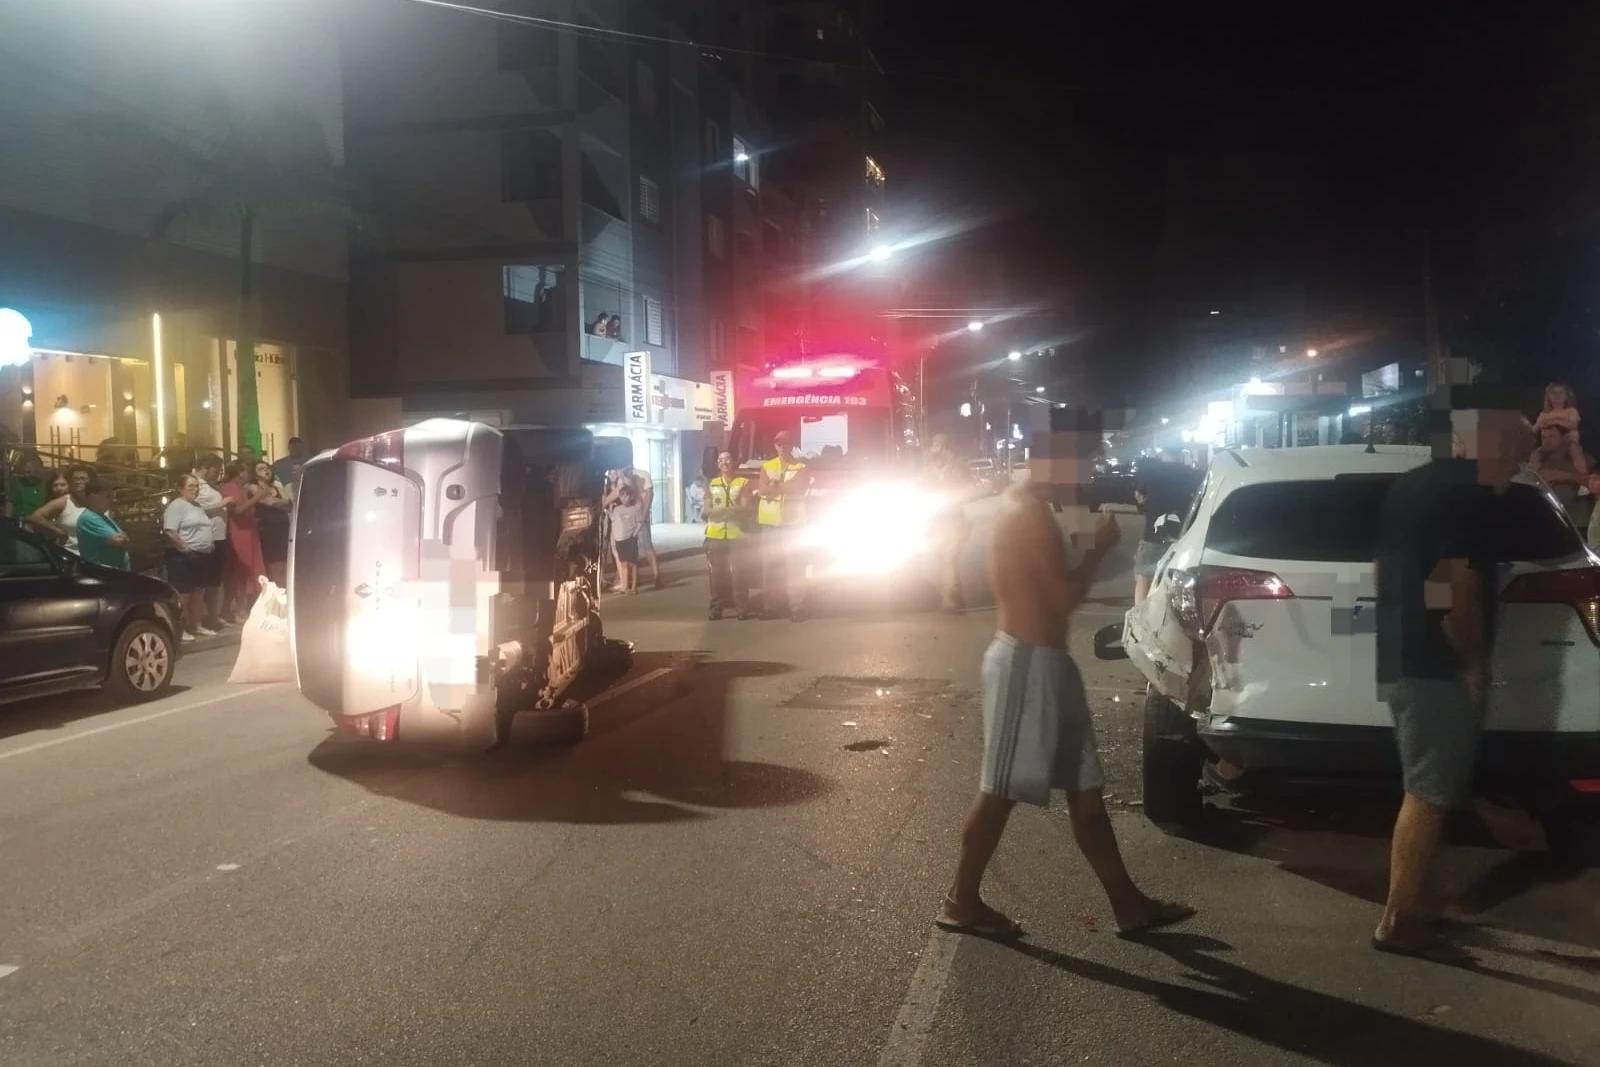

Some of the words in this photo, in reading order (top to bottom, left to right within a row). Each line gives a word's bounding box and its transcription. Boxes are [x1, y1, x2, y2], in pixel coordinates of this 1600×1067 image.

[628, 354, 644, 419] FARMÁCIA
[763, 394, 841, 407] EMERGÊNCIA
[843, 396, 867, 406] 193
